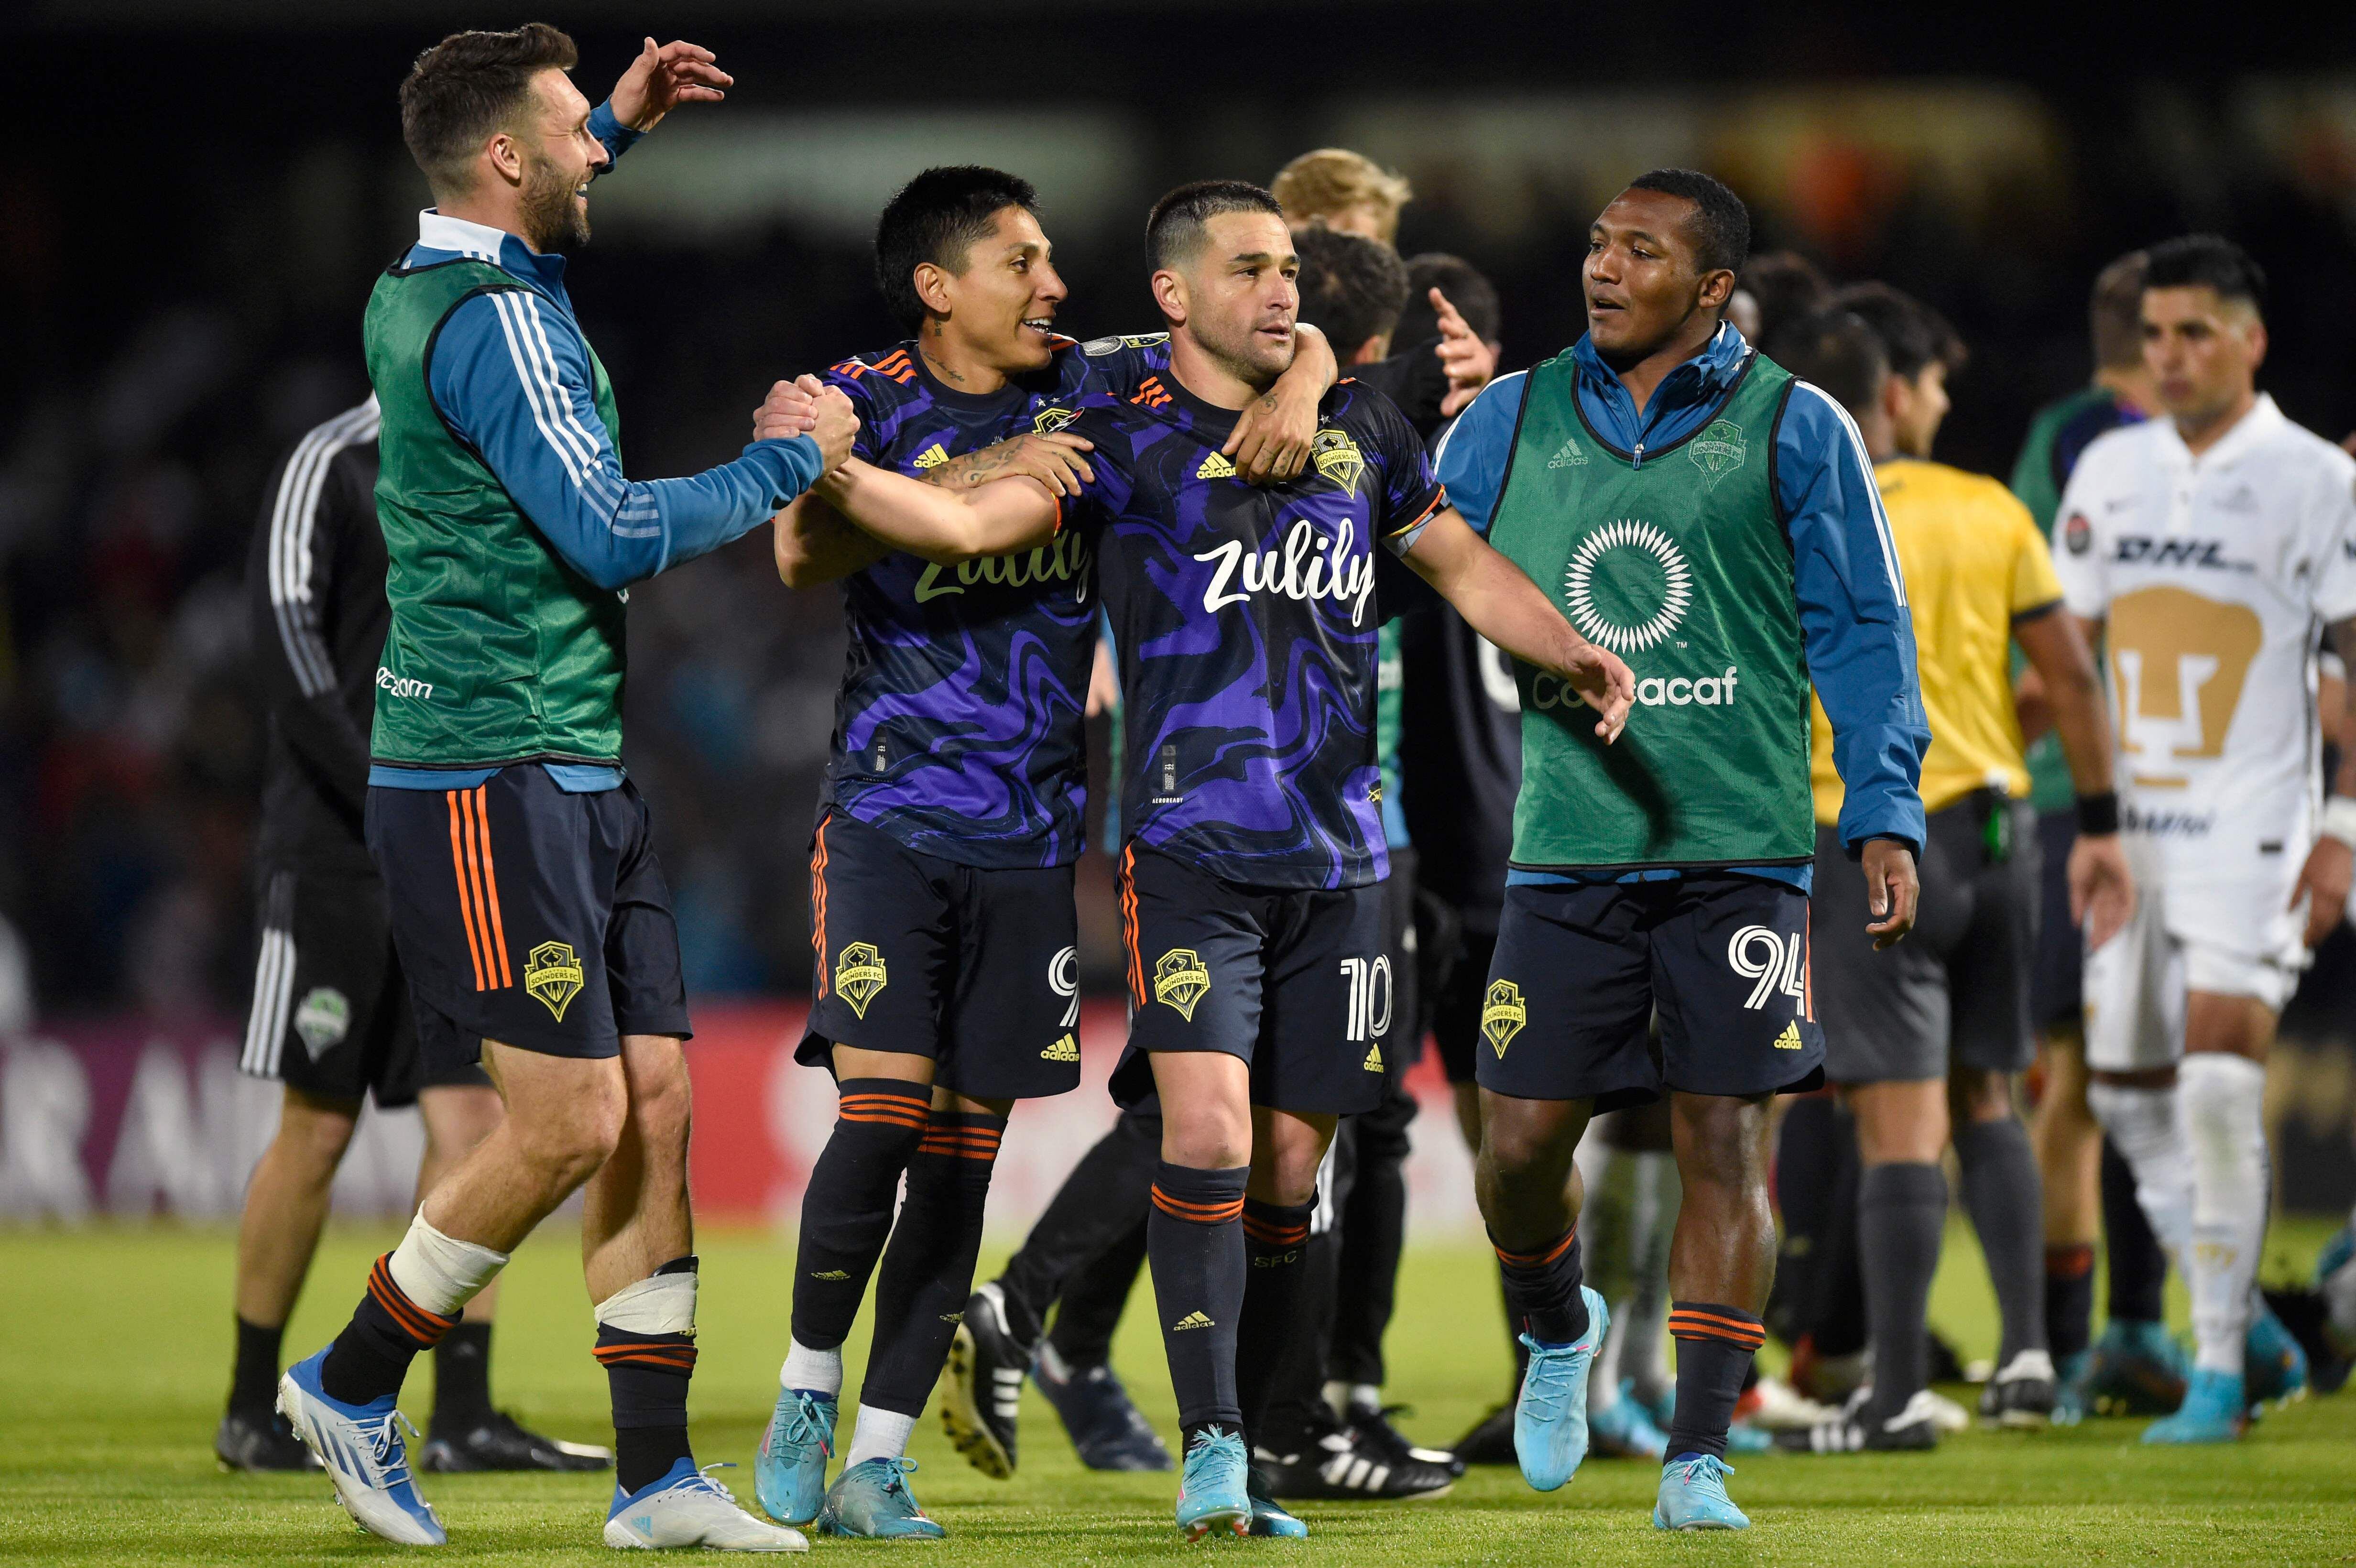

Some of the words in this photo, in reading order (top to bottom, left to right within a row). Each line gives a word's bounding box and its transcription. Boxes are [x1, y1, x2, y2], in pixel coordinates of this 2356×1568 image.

[1320, 454, 1351, 467] SOUNDERS
[1548, 457, 1588, 469] adidas
[2117, 534, 2226, 569] DHL
[1533, 666, 1737, 709] Coacaf
[1728, 925, 1805, 1016] 94
[531, 972, 568, 986] SOUNDERS
[840, 971, 872, 986] SOUNDERS
[1160, 976, 1194, 993] SOUNDERS
[1048, 946, 1080, 1027] 9
[1340, 954, 1392, 1041] 10
[1485, 1012, 1512, 1023] SOUNDERS
[1774, 1036, 1802, 1050] adidas
[1041, 1050, 1080, 1062] adidas
[1364, 1060, 1385, 1074] adidas
[1174, 1321, 1215, 1331] adidas
